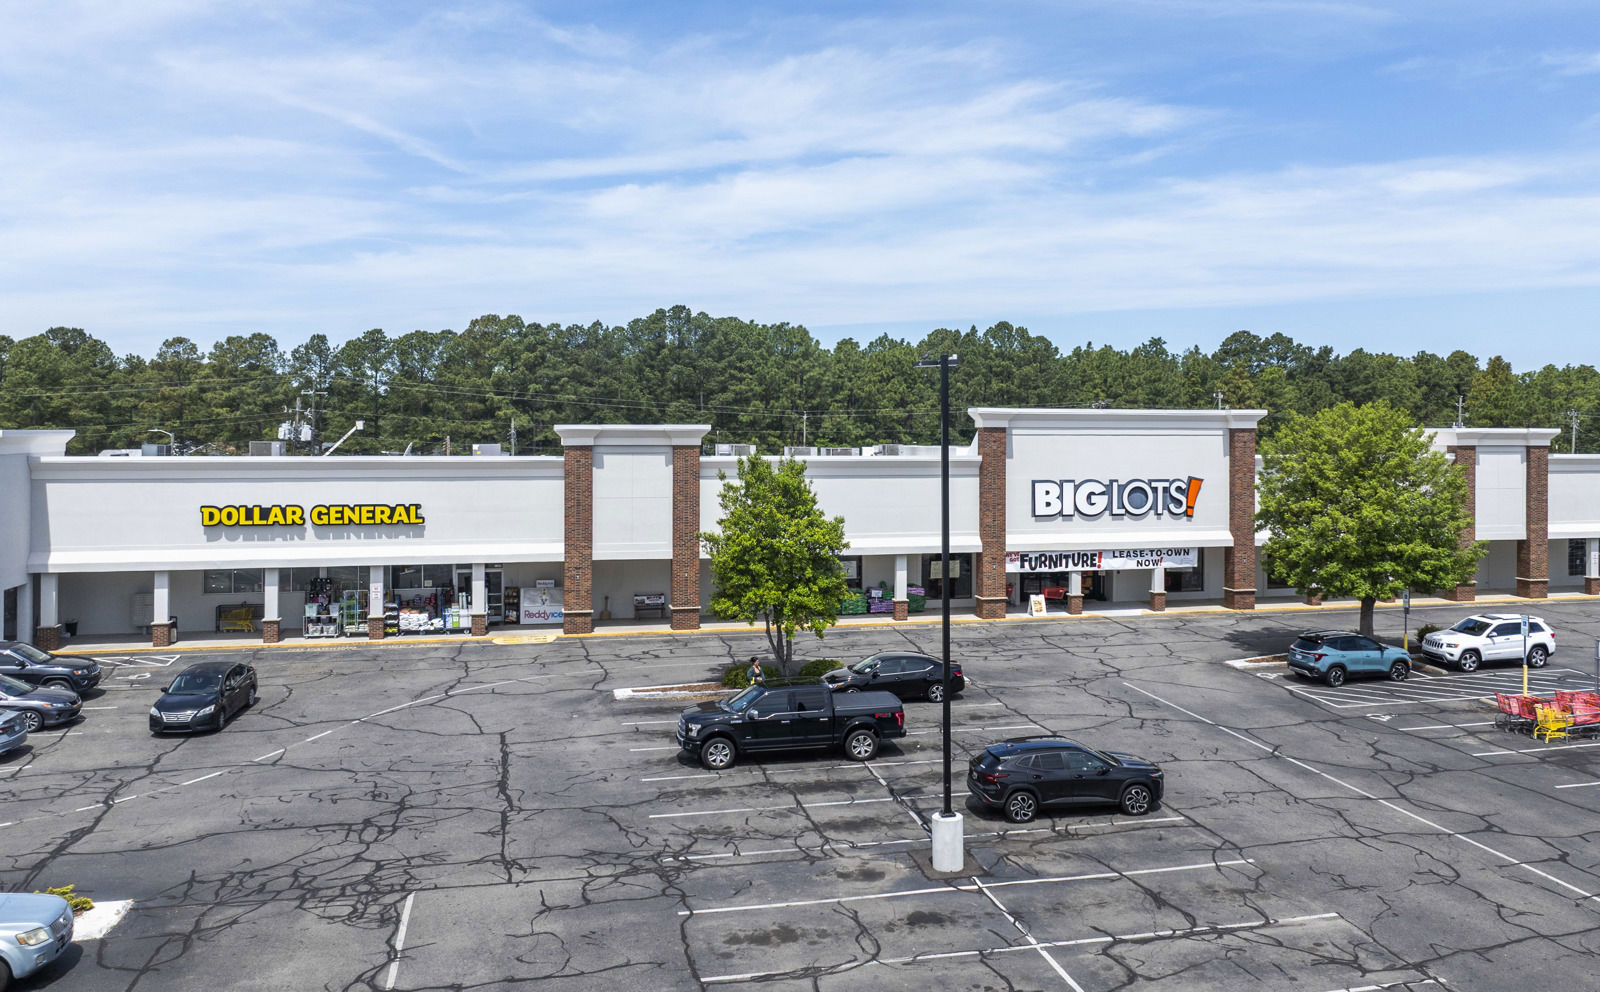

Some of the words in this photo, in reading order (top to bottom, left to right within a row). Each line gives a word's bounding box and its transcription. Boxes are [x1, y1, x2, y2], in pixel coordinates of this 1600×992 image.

[200, 505, 305, 526] DOLLAR
[310, 504, 424, 525] GENERAL
[1112, 548, 1190, 558] LEASE-TO-OWN
[1020, 552, 1103, 571] FURNITURE!
[1136, 557, 1163, 567] NOW!
